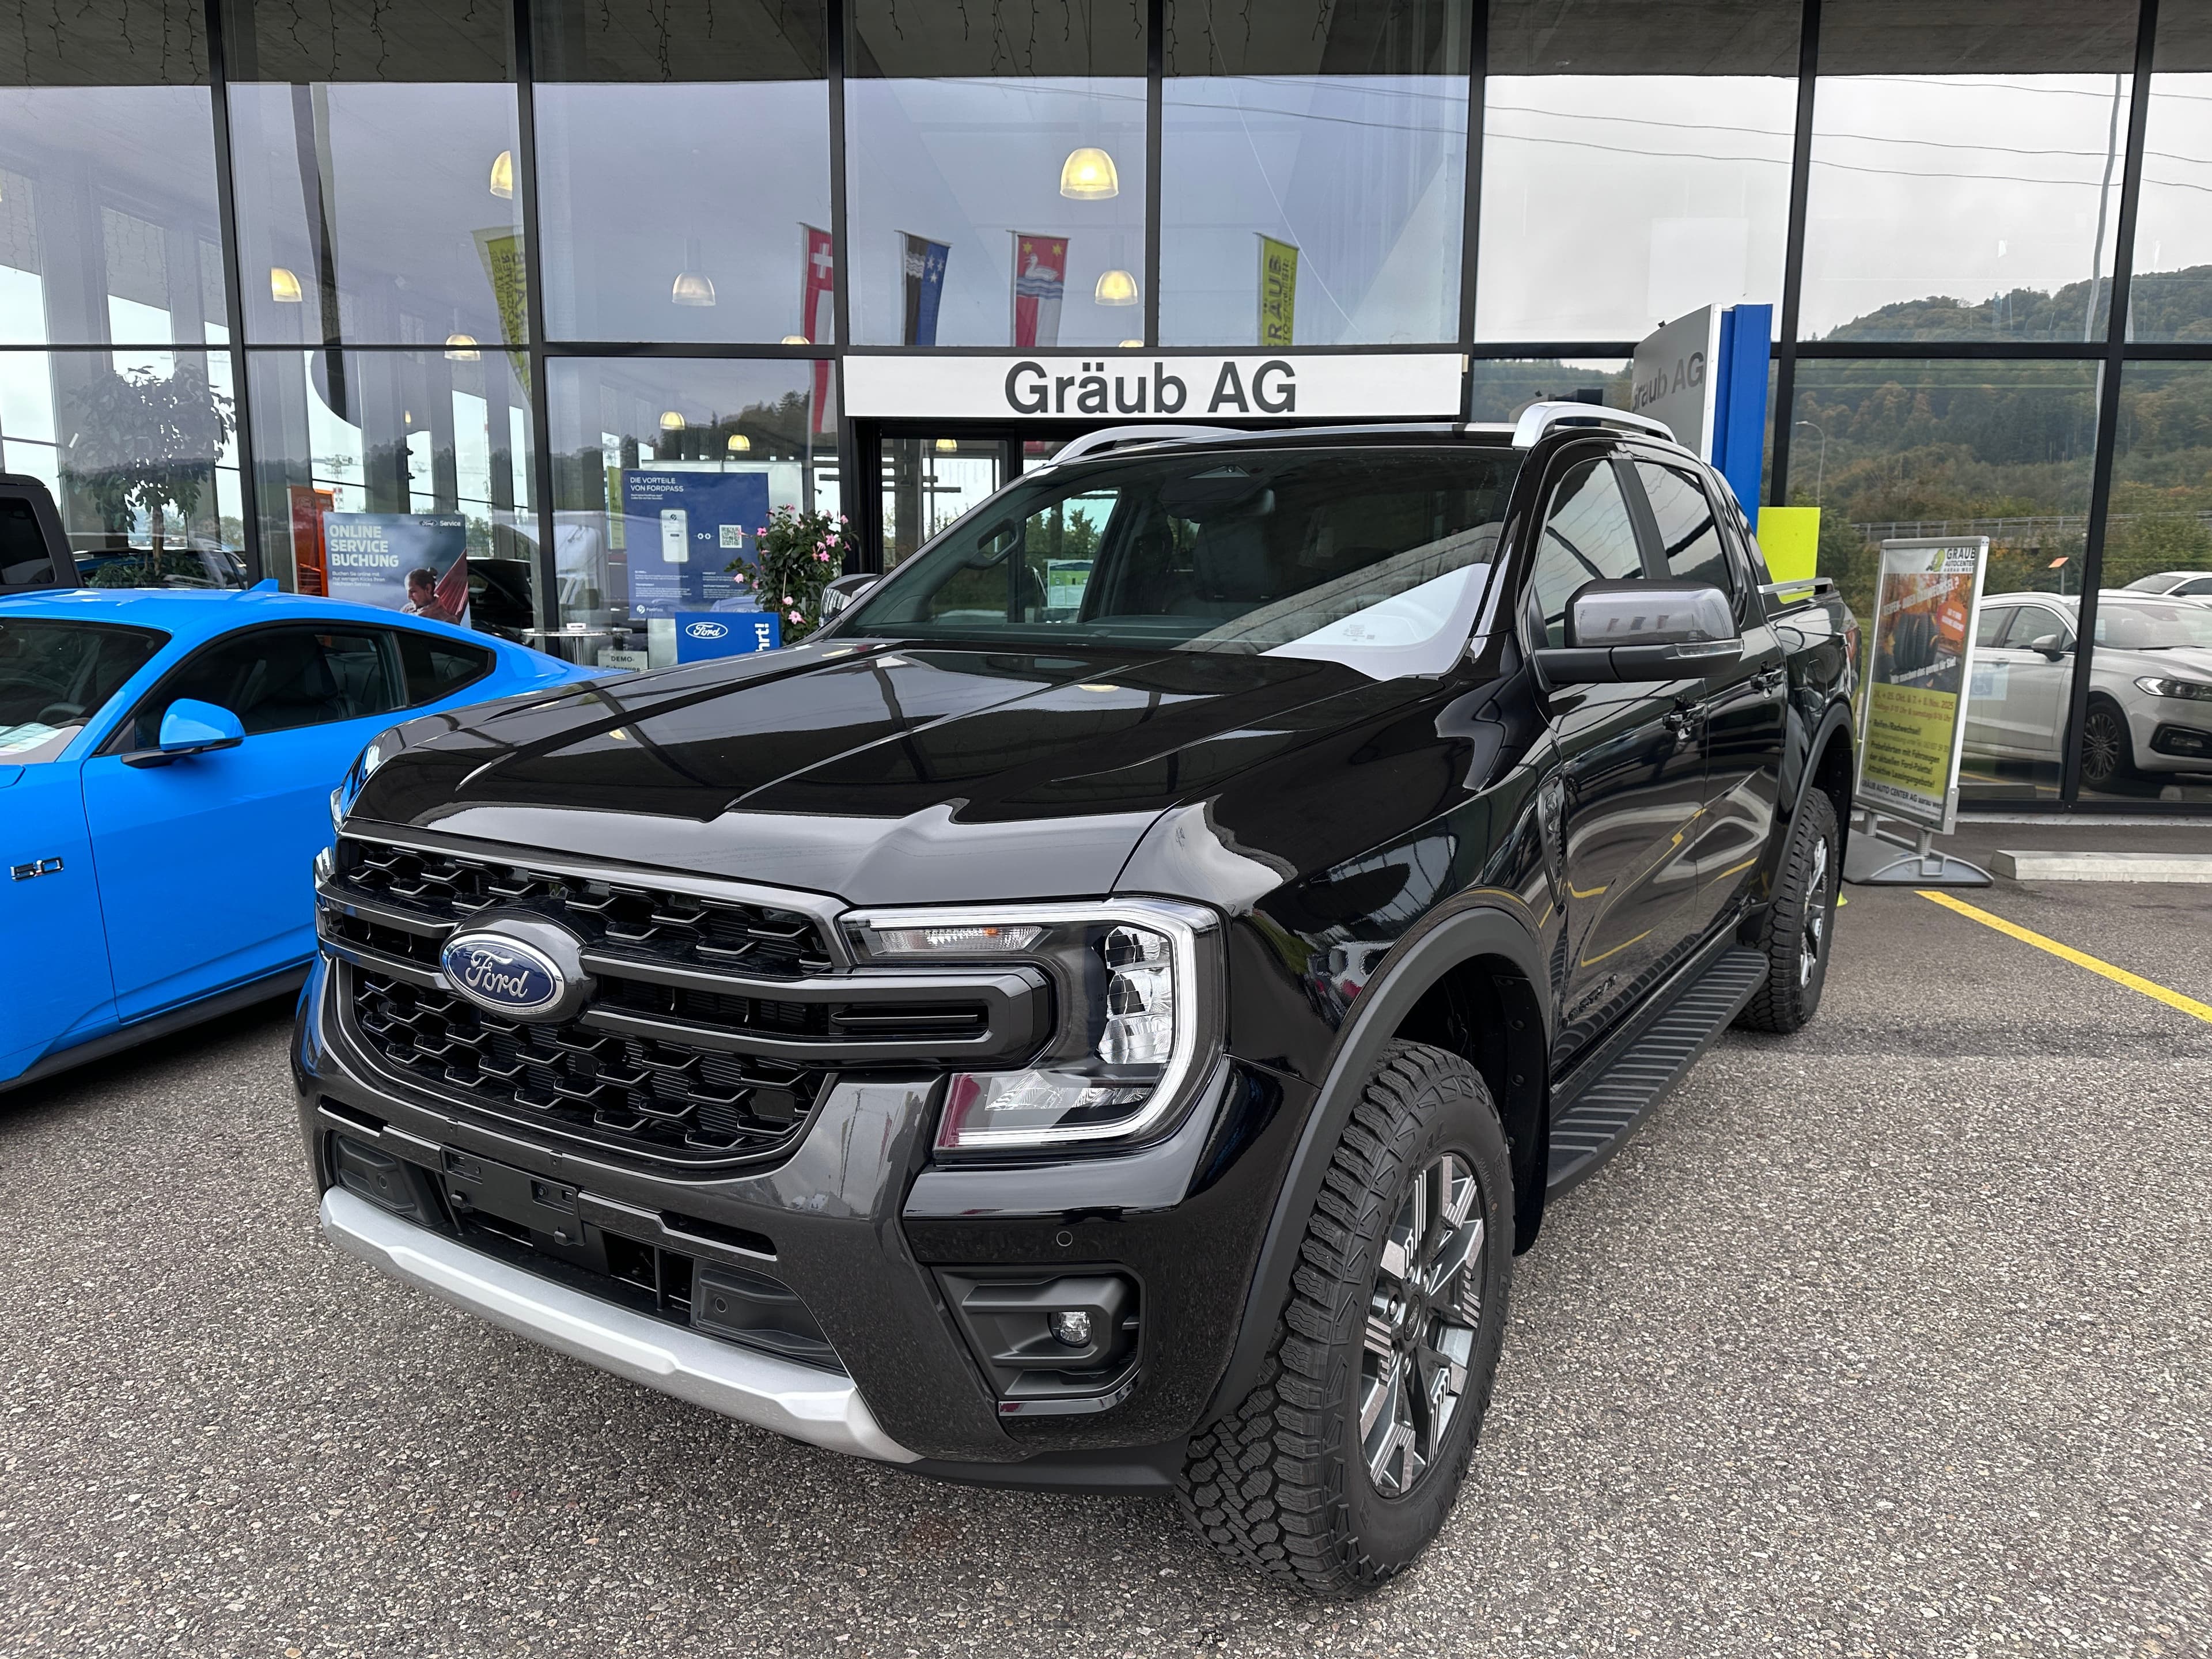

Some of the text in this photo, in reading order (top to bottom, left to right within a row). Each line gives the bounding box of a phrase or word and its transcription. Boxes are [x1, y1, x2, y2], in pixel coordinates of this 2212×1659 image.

[1672, 352, 1704, 394] AG
[1005, 360, 1296, 414] Gräub AG
[329, 525, 382, 538] ONLINE
[331, 540, 388, 553] SERVICE
[331, 554, 399, 567] BUCHUNG
